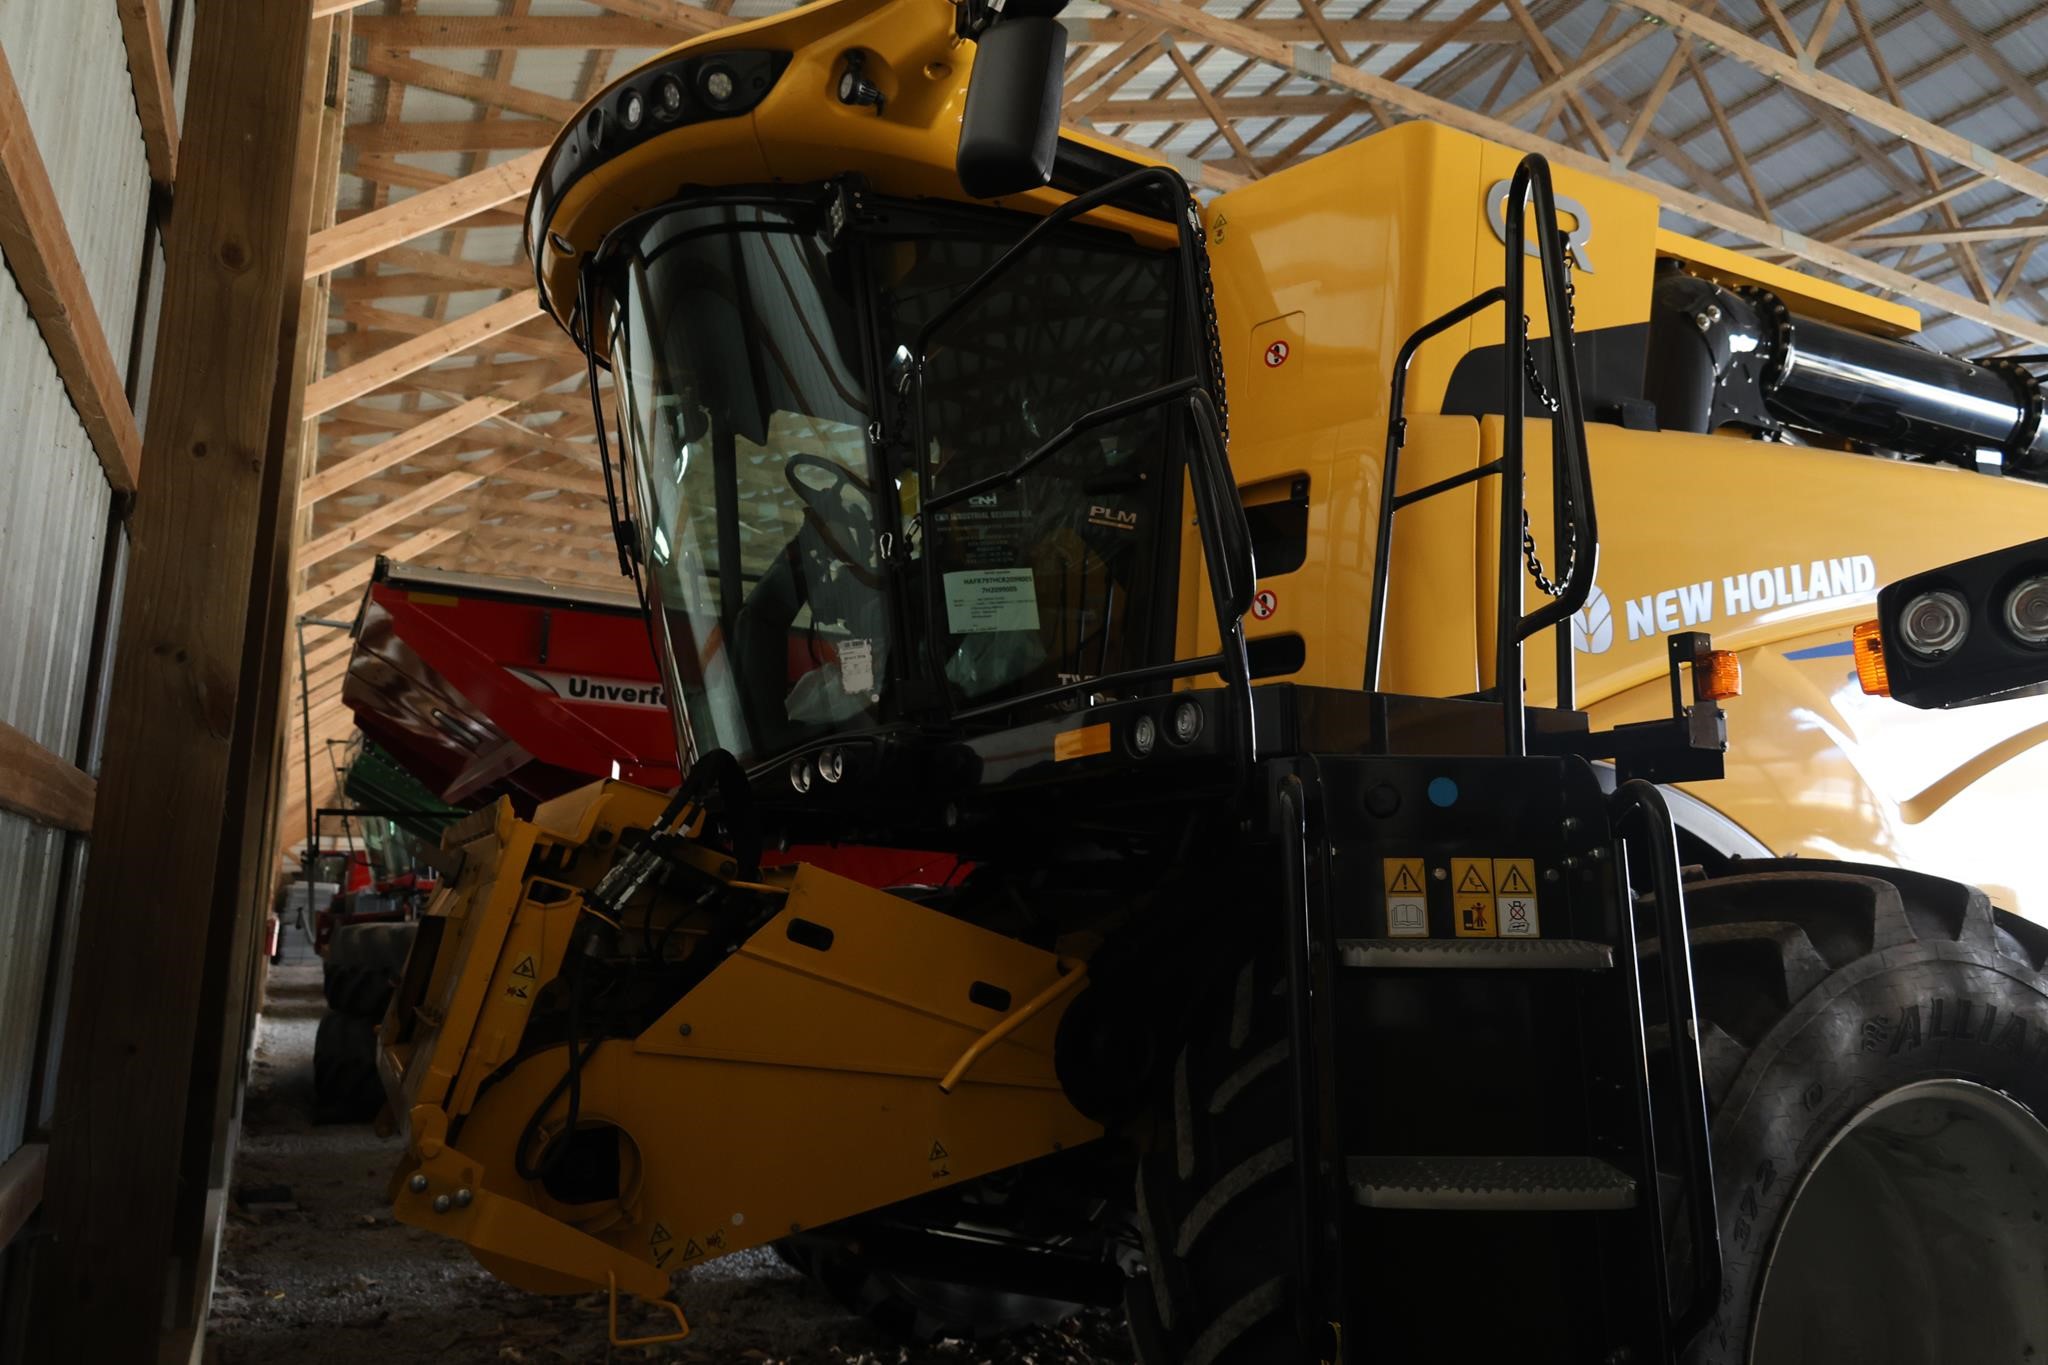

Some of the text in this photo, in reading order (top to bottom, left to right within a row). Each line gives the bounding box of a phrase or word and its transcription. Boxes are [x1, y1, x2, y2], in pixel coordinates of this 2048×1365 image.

[1089, 505, 1137, 524] PLM
[1625, 554, 1876, 641] NEW HOLLAND
